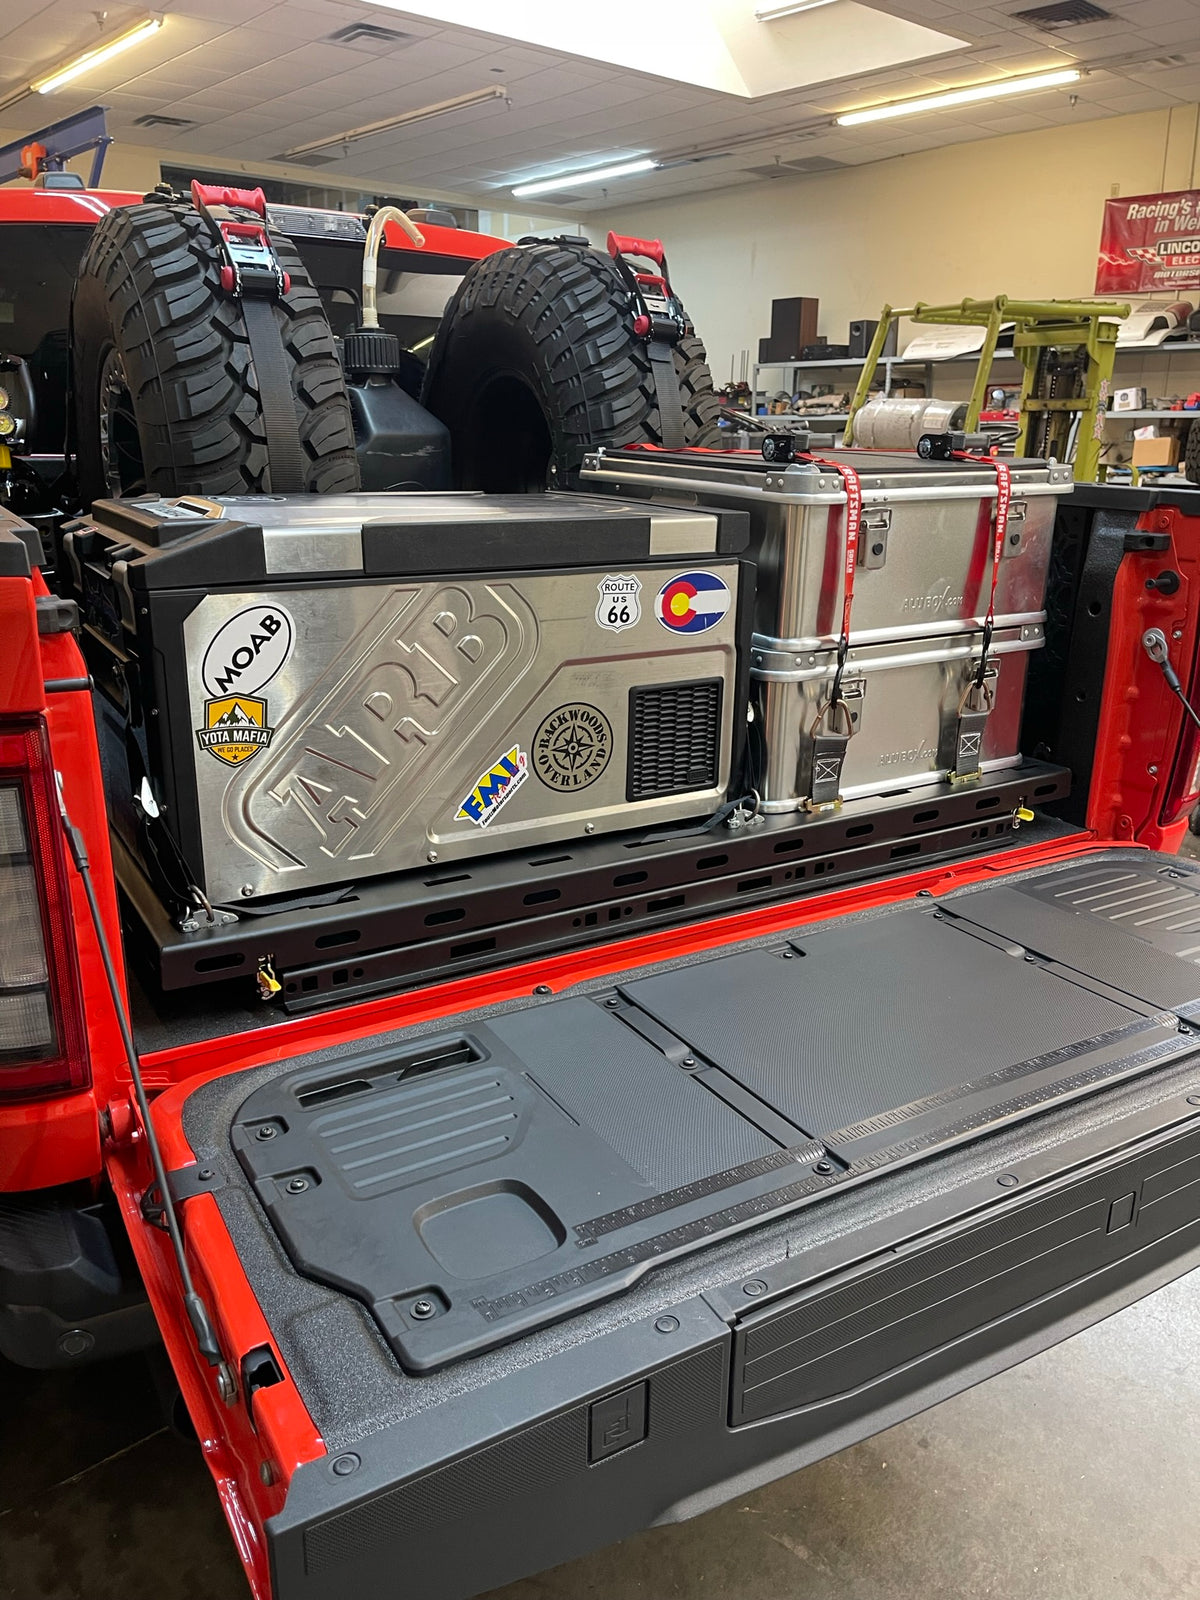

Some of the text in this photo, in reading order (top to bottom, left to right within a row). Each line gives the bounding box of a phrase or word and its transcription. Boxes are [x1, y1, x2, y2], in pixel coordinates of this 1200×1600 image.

[1126, 198, 1192, 220] Racing's
[1154, 217, 1170, 234] in
[1172, 255, 1200, 265] ELEC
[604, 582, 635, 592] ROUTE
[607, 605, 630, 624] 66
[213, 614, 282, 694] MOAB
[202, 730, 268, 745] YOTA MAFIA
[538, 709, 607, 749] BACKWOODS
[538, 748, 607, 786] OVERLAND
[461, 756, 520, 821] FMI
